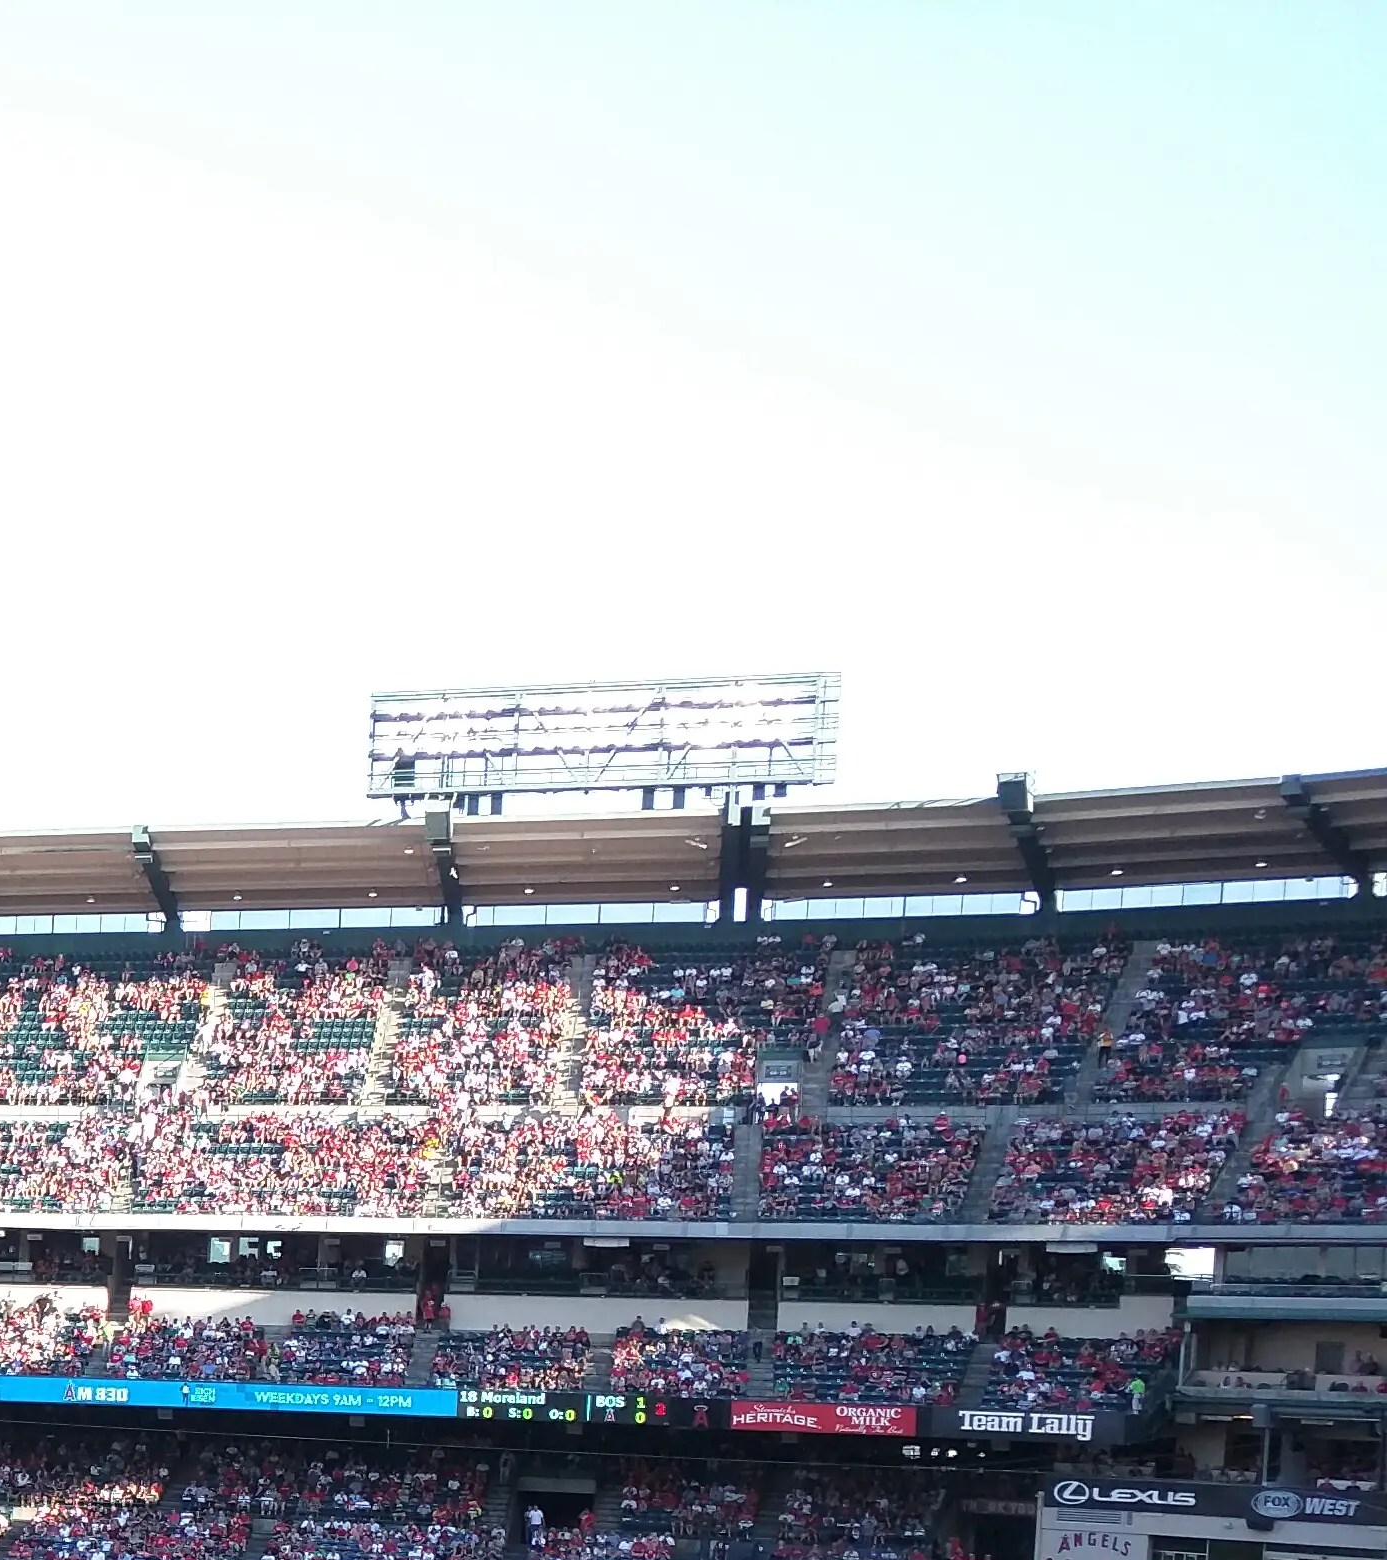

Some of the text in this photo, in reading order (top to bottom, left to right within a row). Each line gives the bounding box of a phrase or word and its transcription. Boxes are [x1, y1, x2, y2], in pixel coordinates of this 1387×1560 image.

[95, 1387, 128, 1402] 830
[254, 1391, 329, 1404] WEEKDAYS
[332, 1394, 362, 1407] 9AM
[377, 1395, 412, 1408] 12PM
[459, 1391, 546, 1405] 18 Moreland
[595, 1396, 645, 1409] BOS 1
[635, 1411, 646, 1424] 0
[835, 1405, 902, 1419] ORGANIC
[732, 1412, 819, 1429] HERITAGE
[850, 1416, 892, 1427] MILK
[958, 1410, 1095, 1441] Team Lally
[1093, 1488, 1196, 1506] LEXUS
[1263, 1495, 1360, 1517] FOX WEST
[1057, 1532, 1132, 1557] ANGELS
